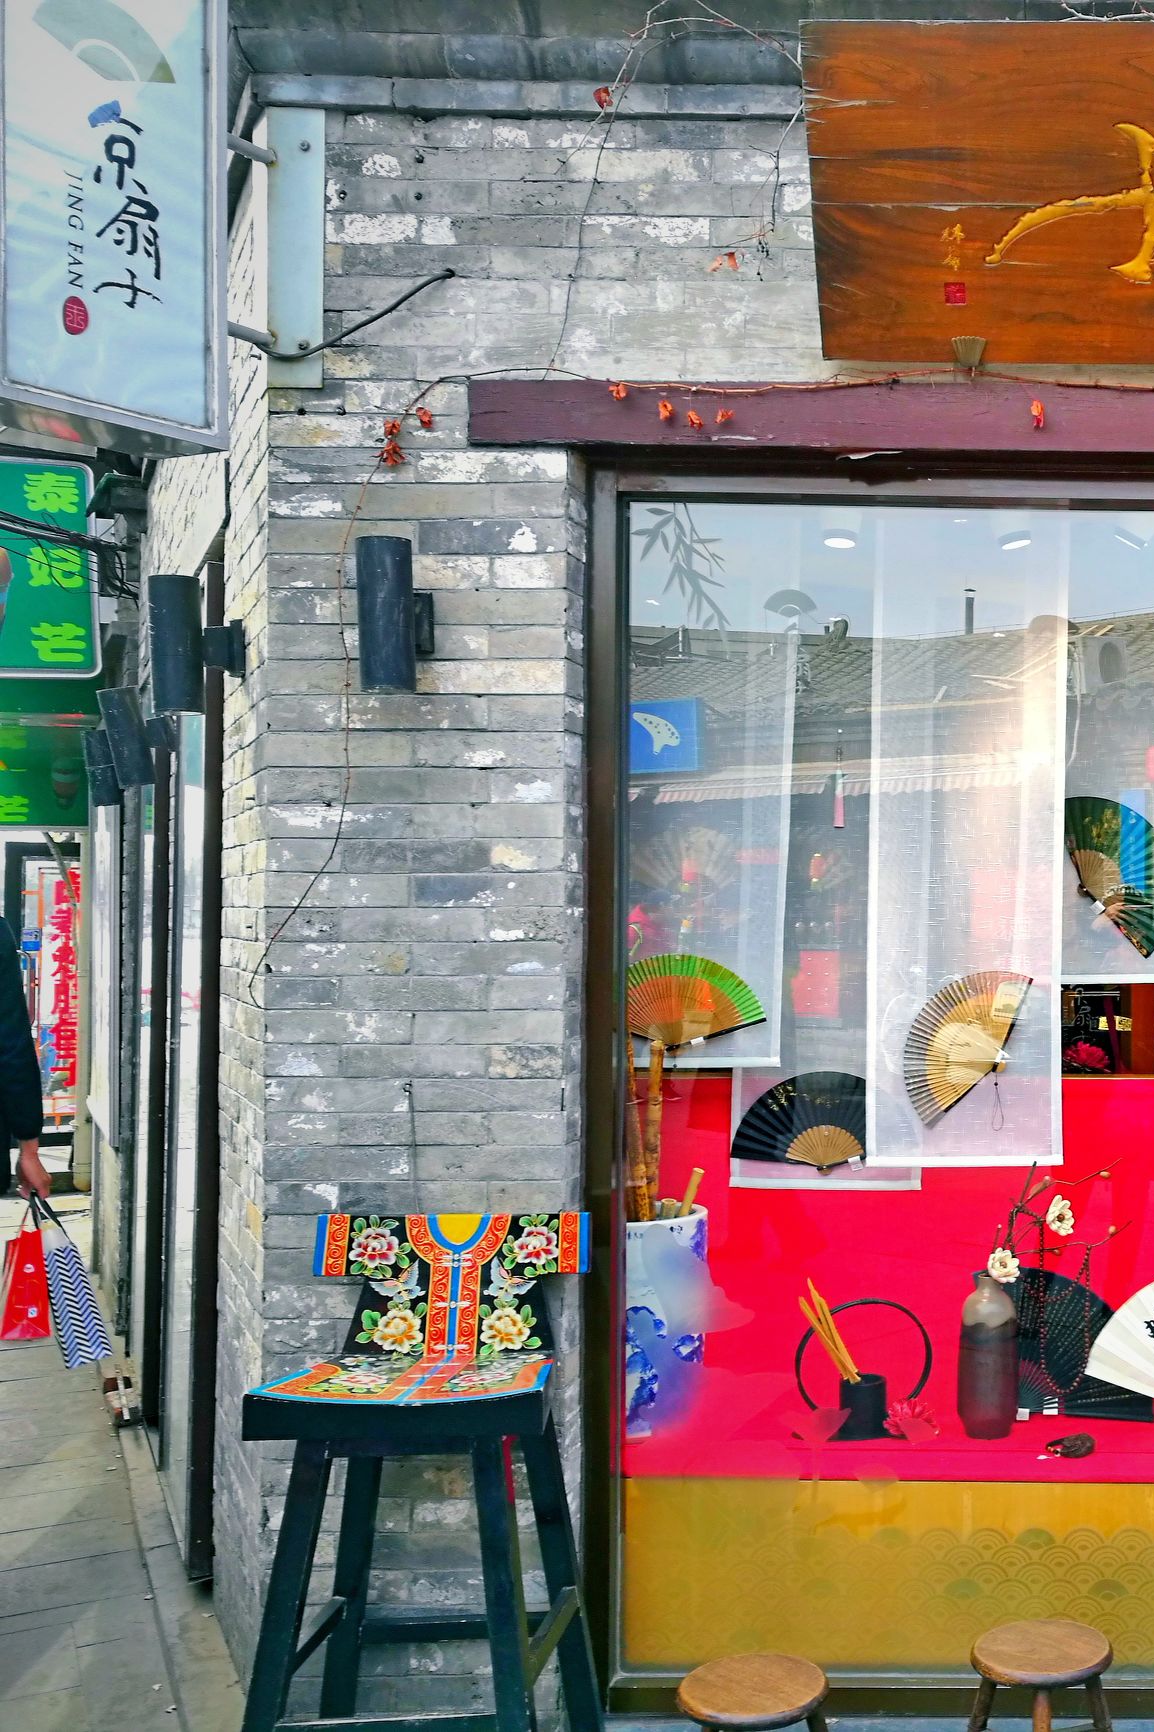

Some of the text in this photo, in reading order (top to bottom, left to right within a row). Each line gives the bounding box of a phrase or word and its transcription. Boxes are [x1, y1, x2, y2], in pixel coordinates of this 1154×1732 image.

[64, 169, 85, 231] JING
[87, 100, 163, 309] 京扇子
[67, 240, 85, 290] FAN
